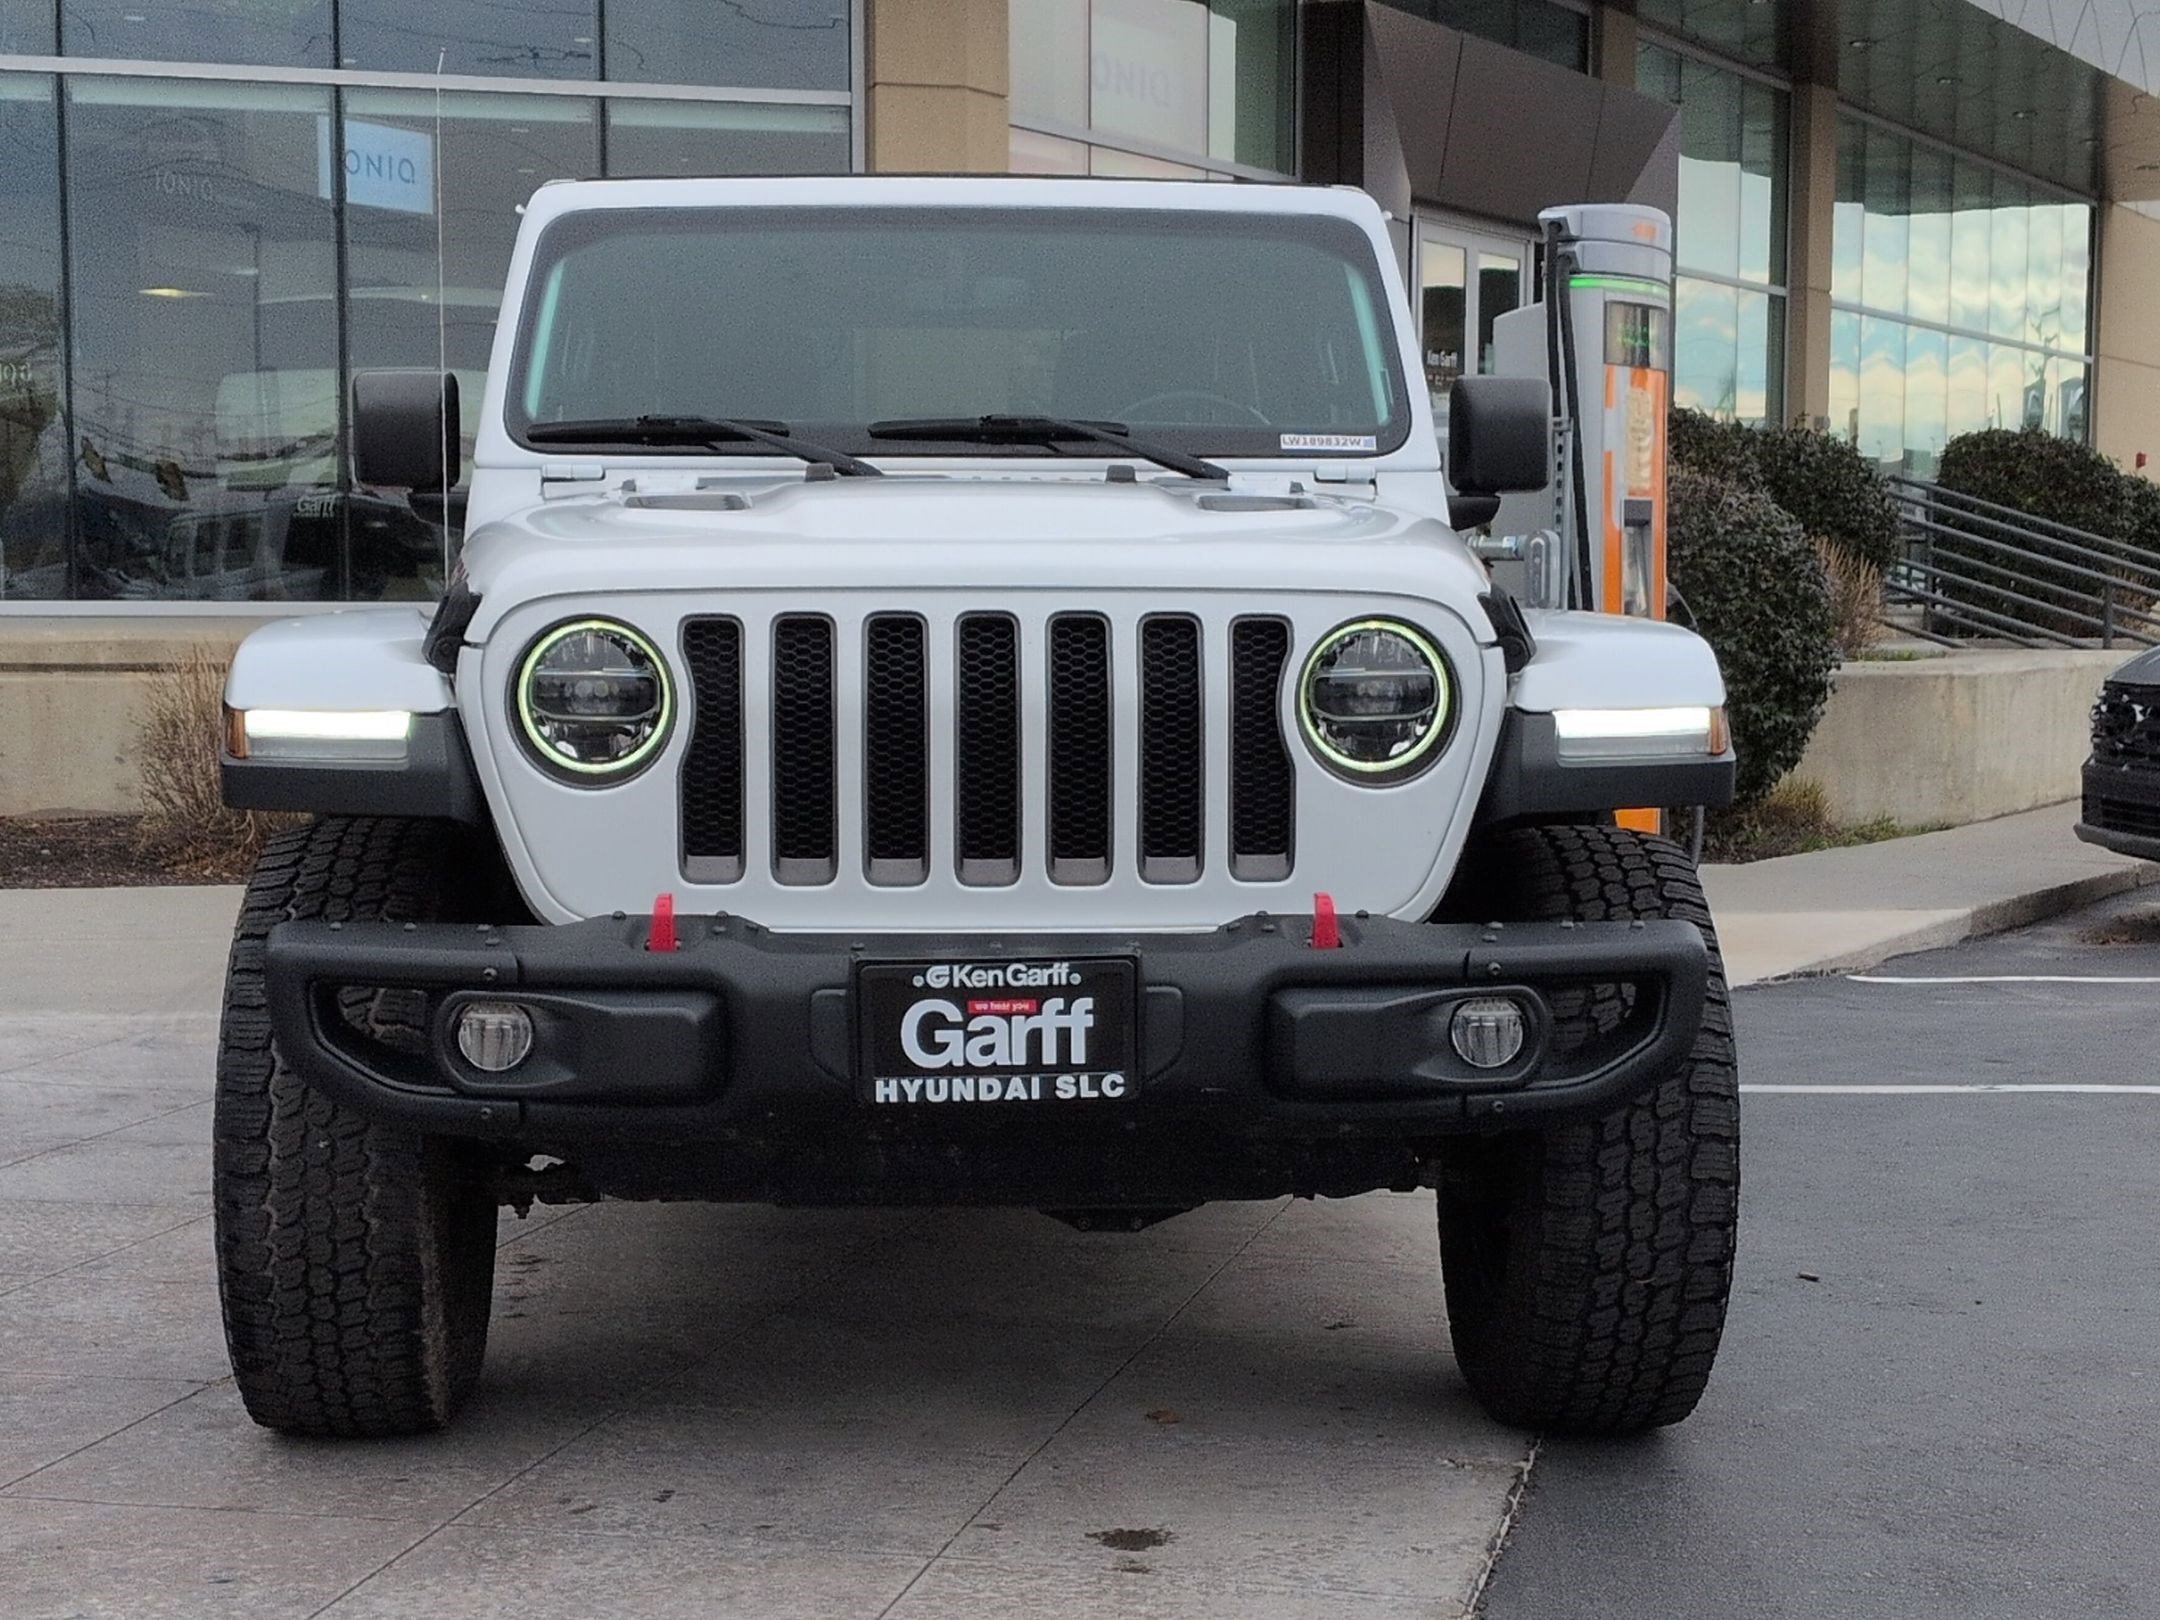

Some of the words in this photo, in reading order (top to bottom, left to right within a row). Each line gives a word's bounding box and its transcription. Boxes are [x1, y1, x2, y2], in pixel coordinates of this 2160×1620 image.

[344, 149, 416, 184] ONIQ
[953, 964, 1004, 988] Ken
[1006, 962, 1070, 987] Garff
[900, 997, 1094, 1069] Garff
[875, 1076, 1040, 1103] HYUNDAI
[1054, 1073, 1125, 1099] SLC
